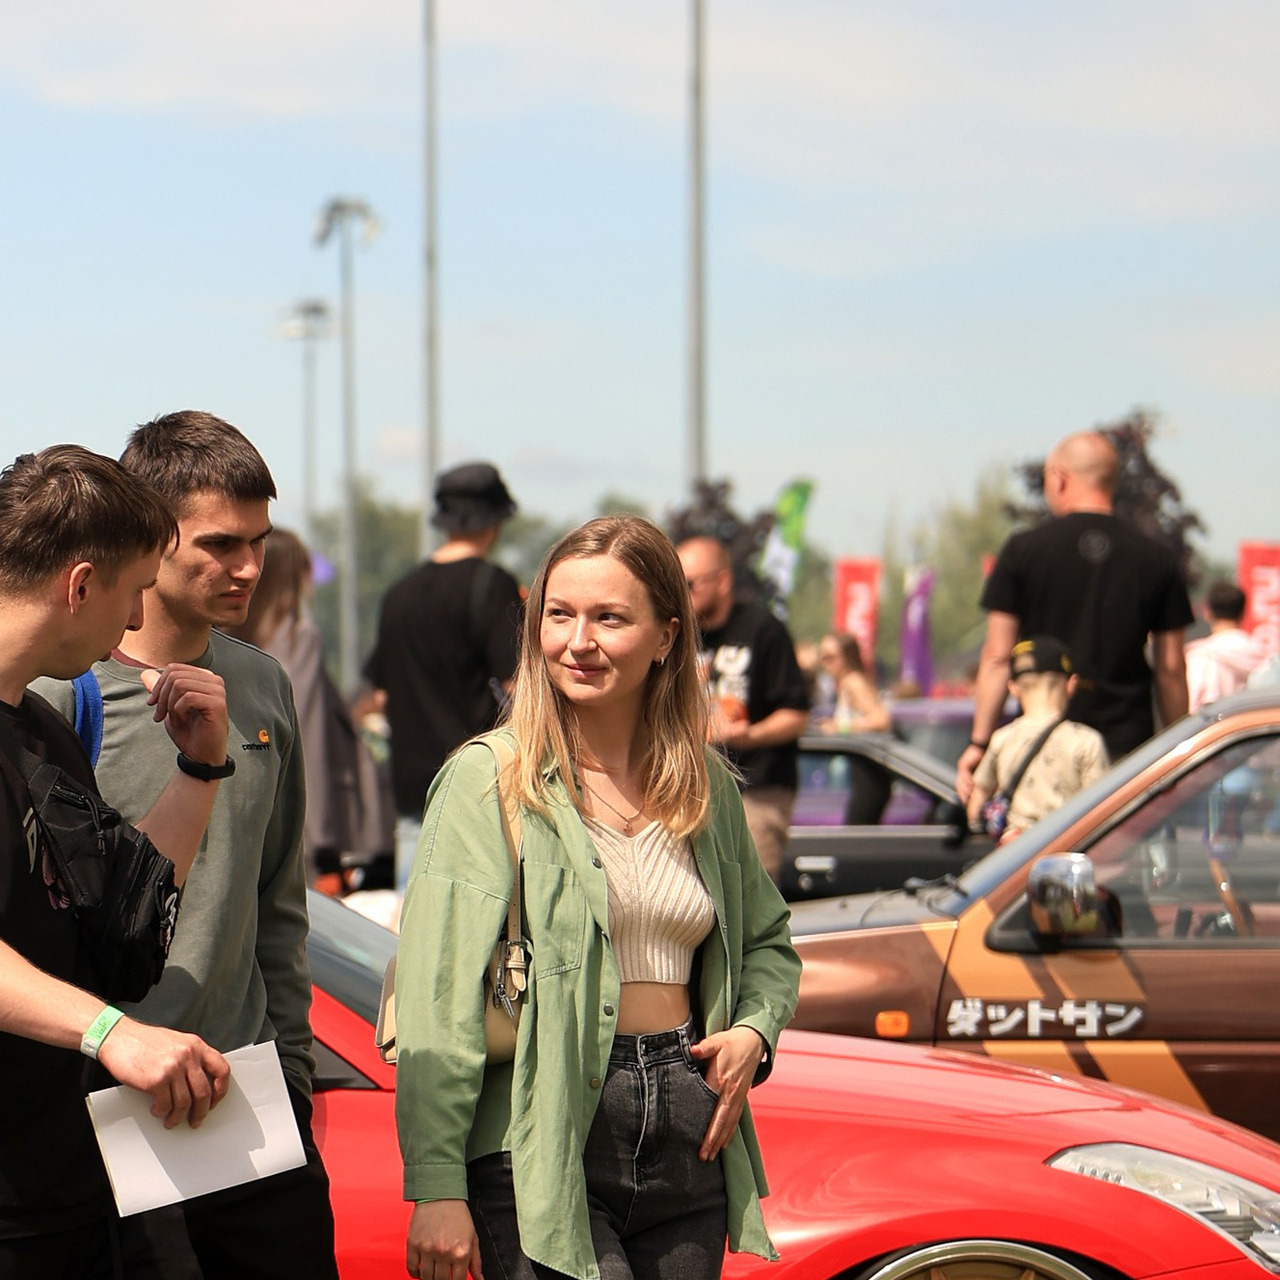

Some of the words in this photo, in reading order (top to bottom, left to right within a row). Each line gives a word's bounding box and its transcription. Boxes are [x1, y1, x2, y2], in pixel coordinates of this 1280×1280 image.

[947, 997, 1144, 1037] ダットサン
